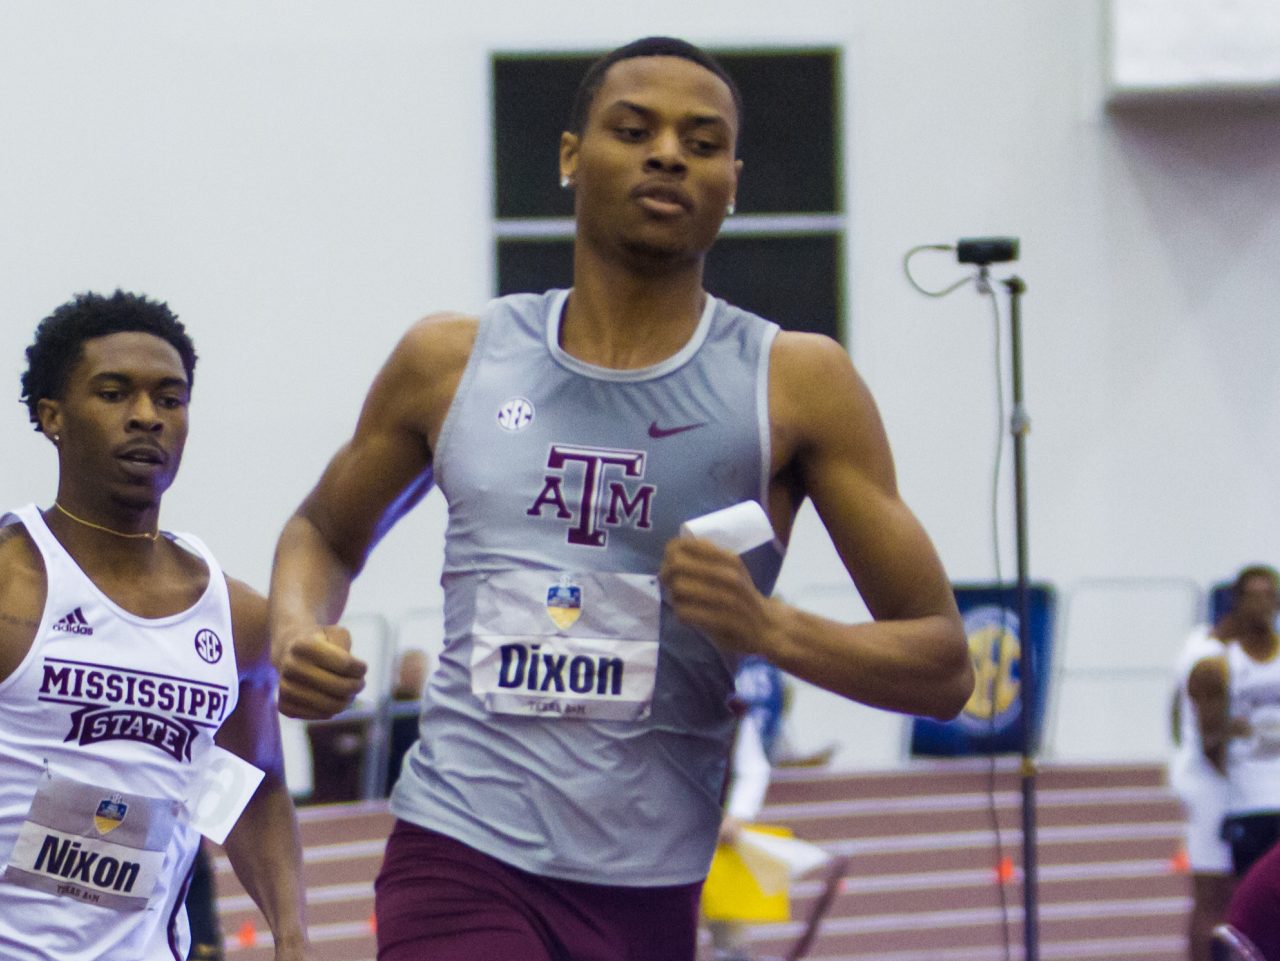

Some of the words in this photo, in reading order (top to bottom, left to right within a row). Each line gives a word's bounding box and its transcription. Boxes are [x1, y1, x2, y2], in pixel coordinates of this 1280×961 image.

[53, 623, 93, 636] adidas
[195, 630, 222, 663] SEC
[498, 644, 624, 695] Dixon
[39, 665, 228, 721] MISSISSIPPI
[91, 715, 179, 750] STATE
[34, 835, 140, 892] Nixon
